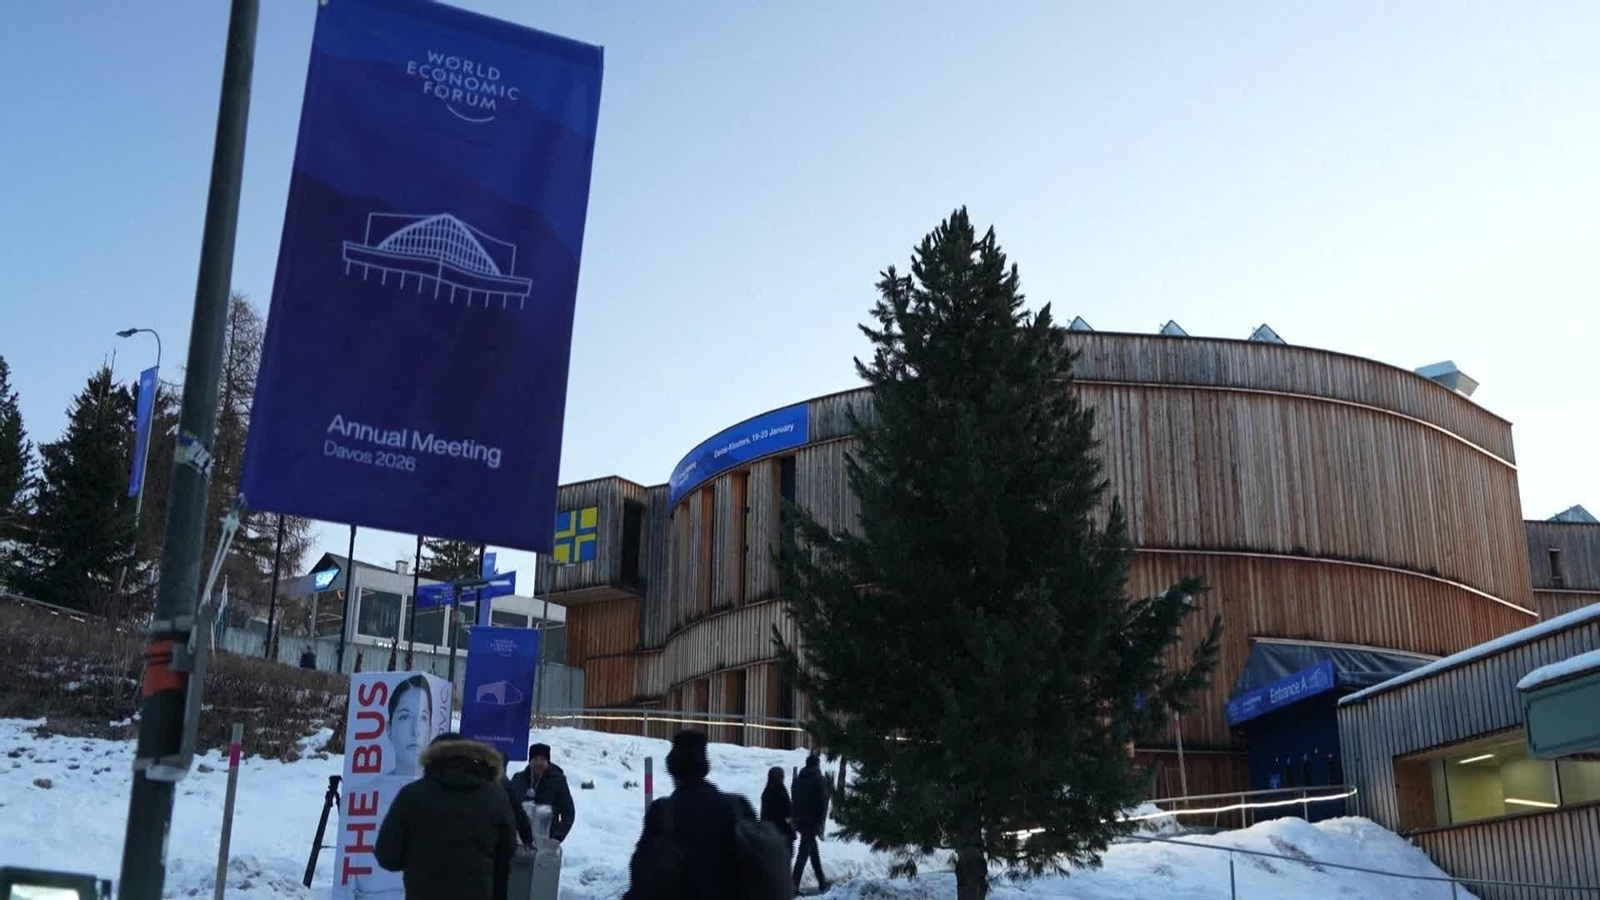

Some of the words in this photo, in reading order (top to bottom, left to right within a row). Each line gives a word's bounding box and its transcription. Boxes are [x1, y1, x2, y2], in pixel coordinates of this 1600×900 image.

[406, 60, 521, 101] ECONOMIC
[427, 49, 501, 81] WORLD
[423, 81, 496, 111] FORUM
[326, 413, 407, 448] Annual
[411, 430, 502, 469] Meeting
[752, 429, 769, 442] 19-23
[769, 423, 795, 437] January
[324, 440, 373, 464] Davos
[375, 451, 416, 472] 2026
[315, 573, 334, 587] SAP
[1269, 682, 1301, 704] Entrance
[1301, 675, 1308, 693] A
[352, 680, 389, 774] BUS
[341, 790, 380, 886] THE
